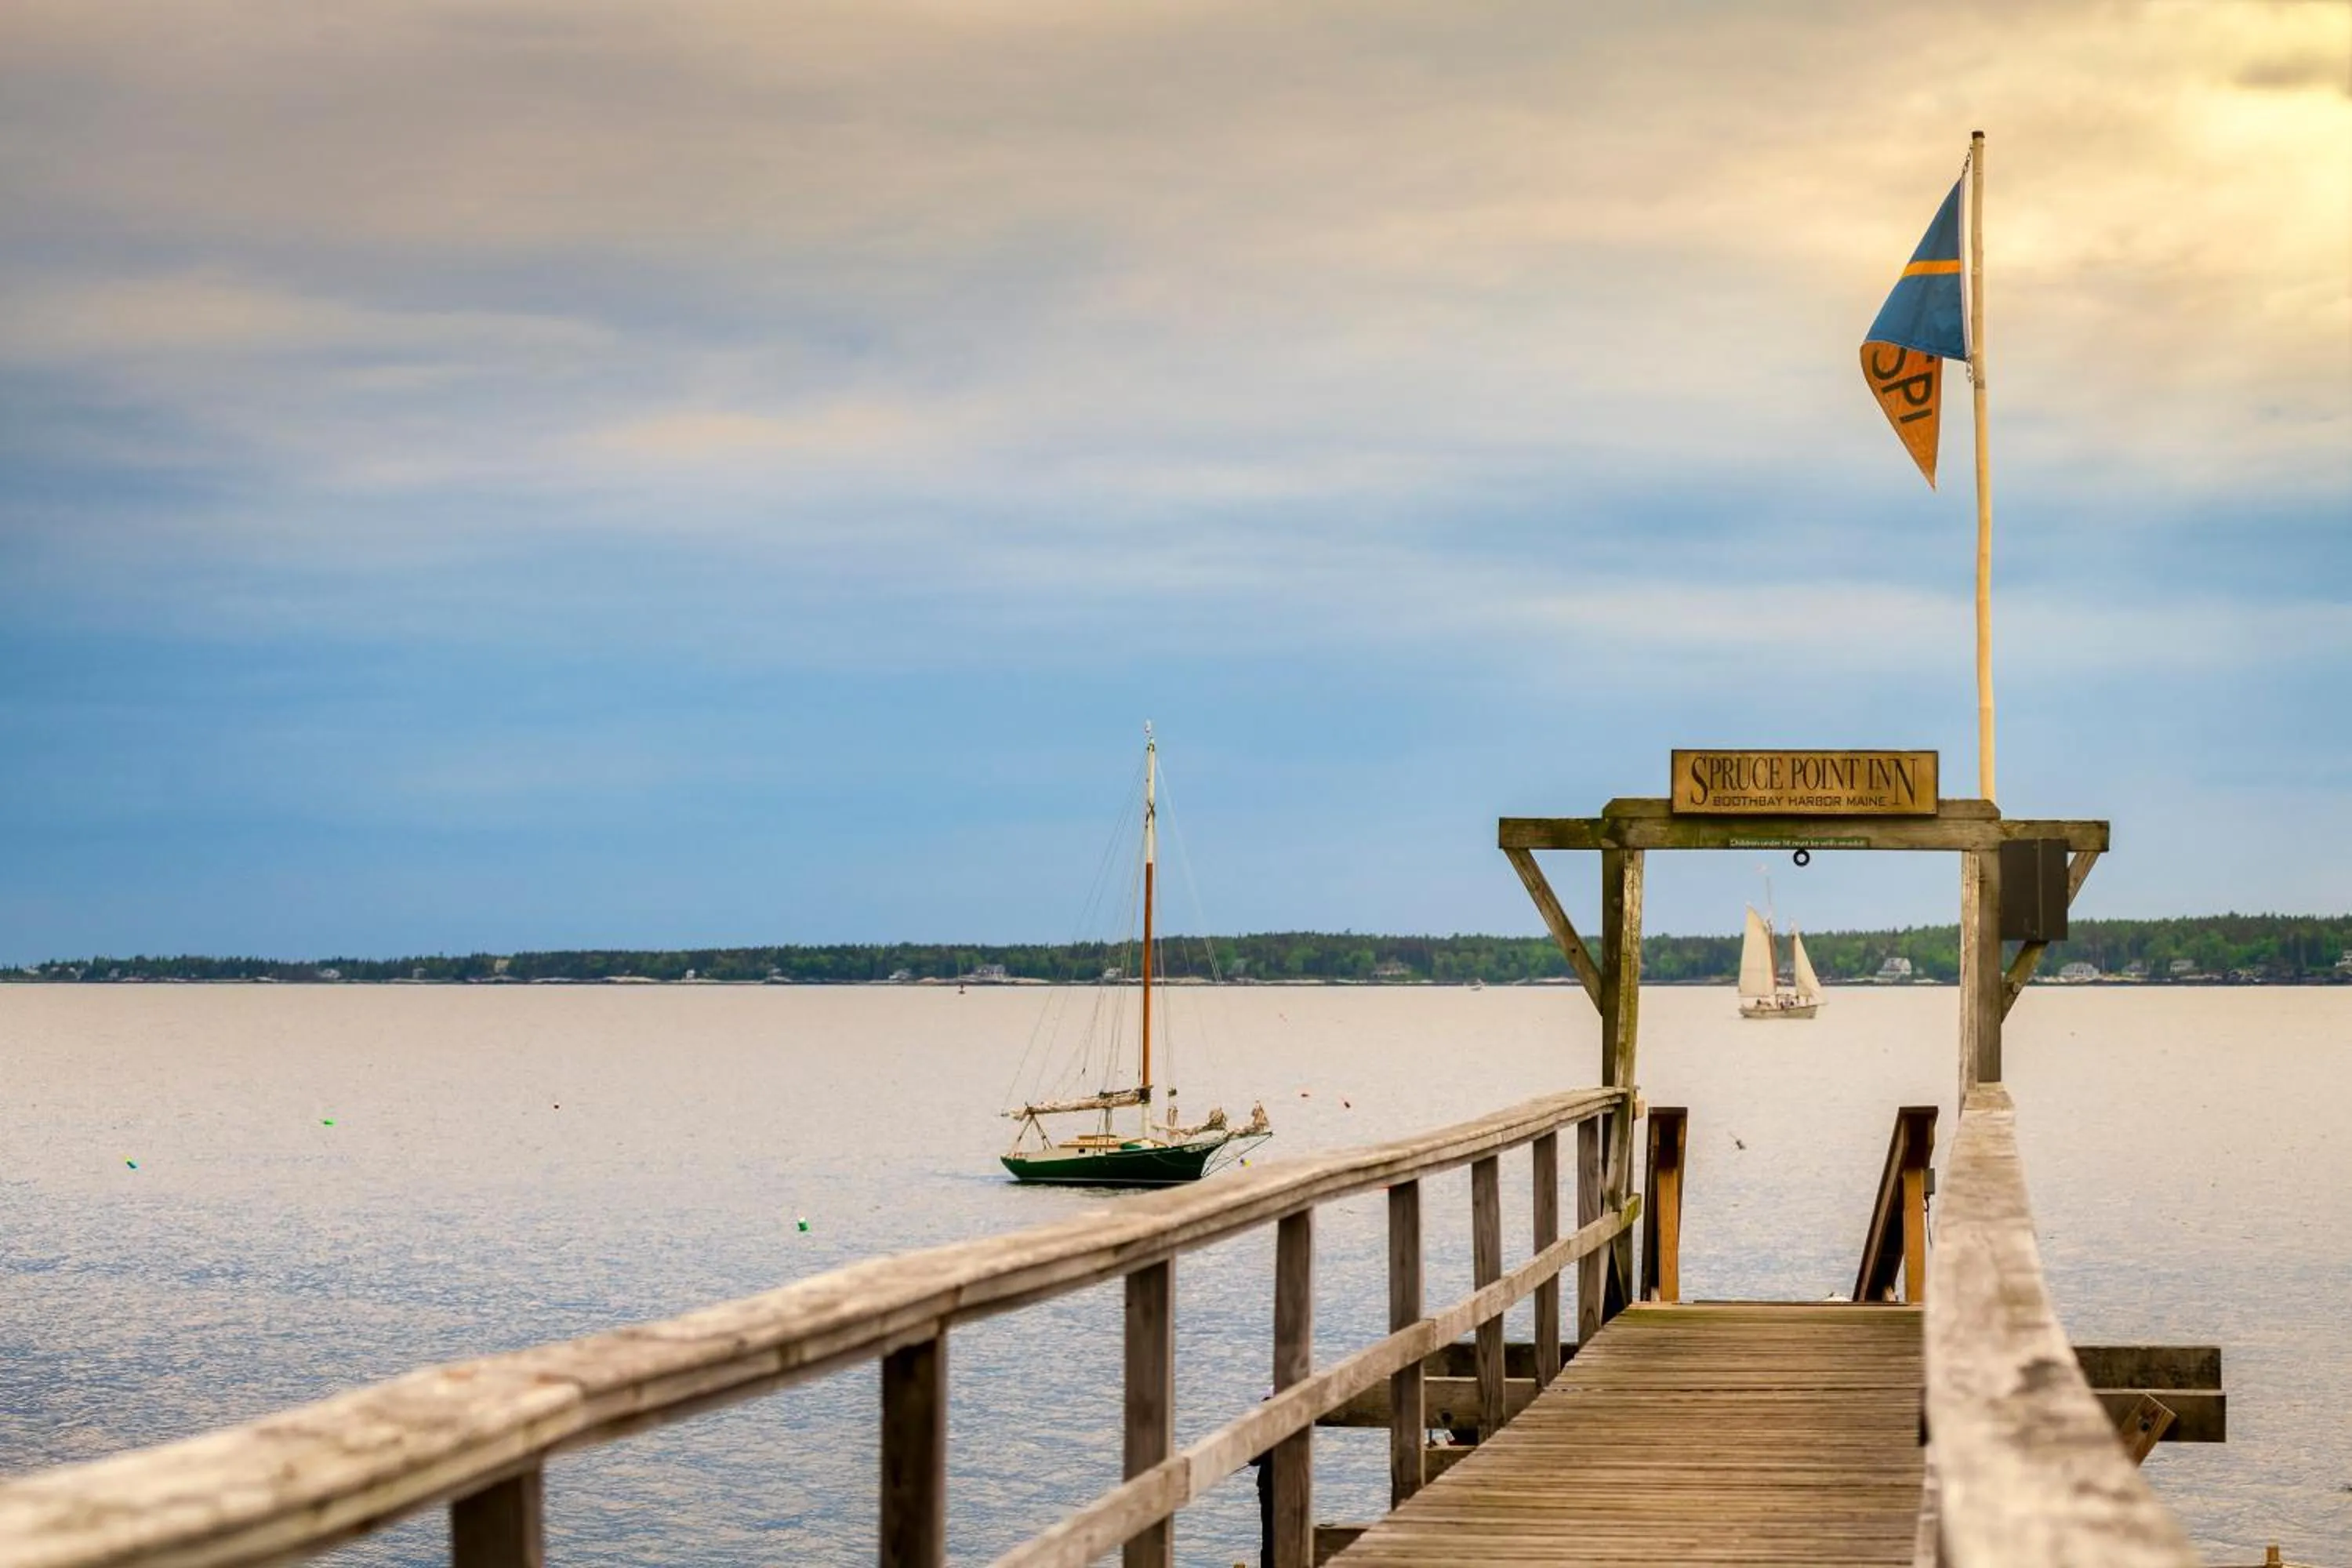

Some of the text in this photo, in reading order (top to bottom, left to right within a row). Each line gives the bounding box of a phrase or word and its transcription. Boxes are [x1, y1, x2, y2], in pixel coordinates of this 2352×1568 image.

[1690, 757, 1918, 805] SPRUCE POINT INN
[1712, 796, 1887, 807] BOOTHBAY HARBOR MAINE
